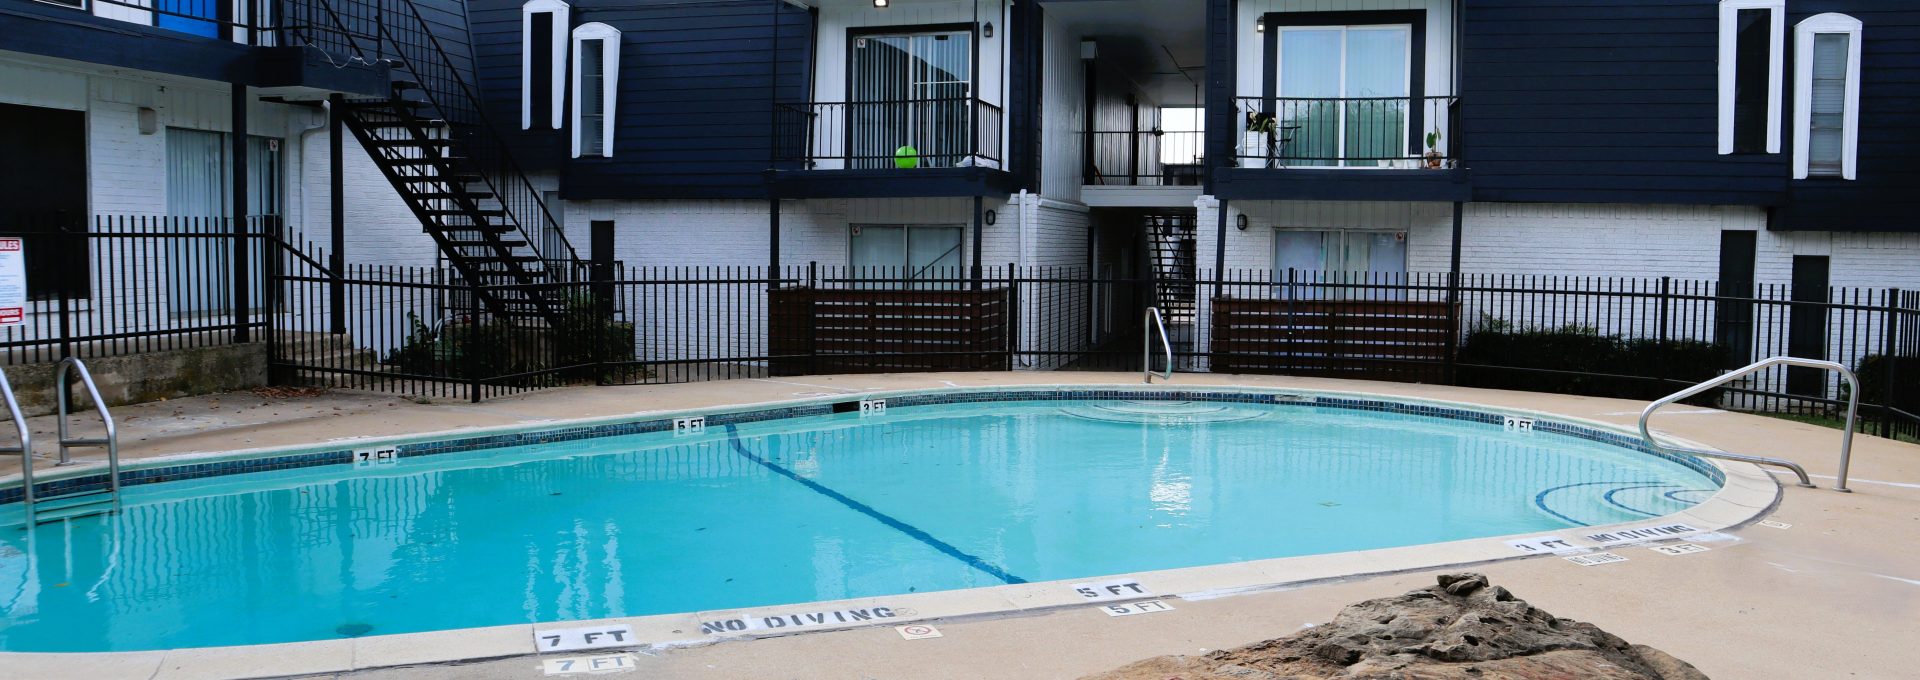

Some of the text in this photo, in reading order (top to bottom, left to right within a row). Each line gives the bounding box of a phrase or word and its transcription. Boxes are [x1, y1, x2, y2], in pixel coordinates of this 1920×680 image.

[874, 401, 885, 410] FT
[690, 418, 704, 428] FT
[1519, 420, 1532, 430] FT
[359, 449, 395, 461] 7 FT
[1587, 525, 1697, 543] NO DIVING
[1515, 539, 1573, 552] 3 FT
[1659, 543, 1706, 554] 3 FT
[1076, 582, 1143, 598] 5 FT
[1108, 600, 1166, 614] 5 FT
[702, 607, 896, 635] NO DIVING
[541, 629, 627, 647] 7 FT
[555, 655, 627, 671] 7 FT
